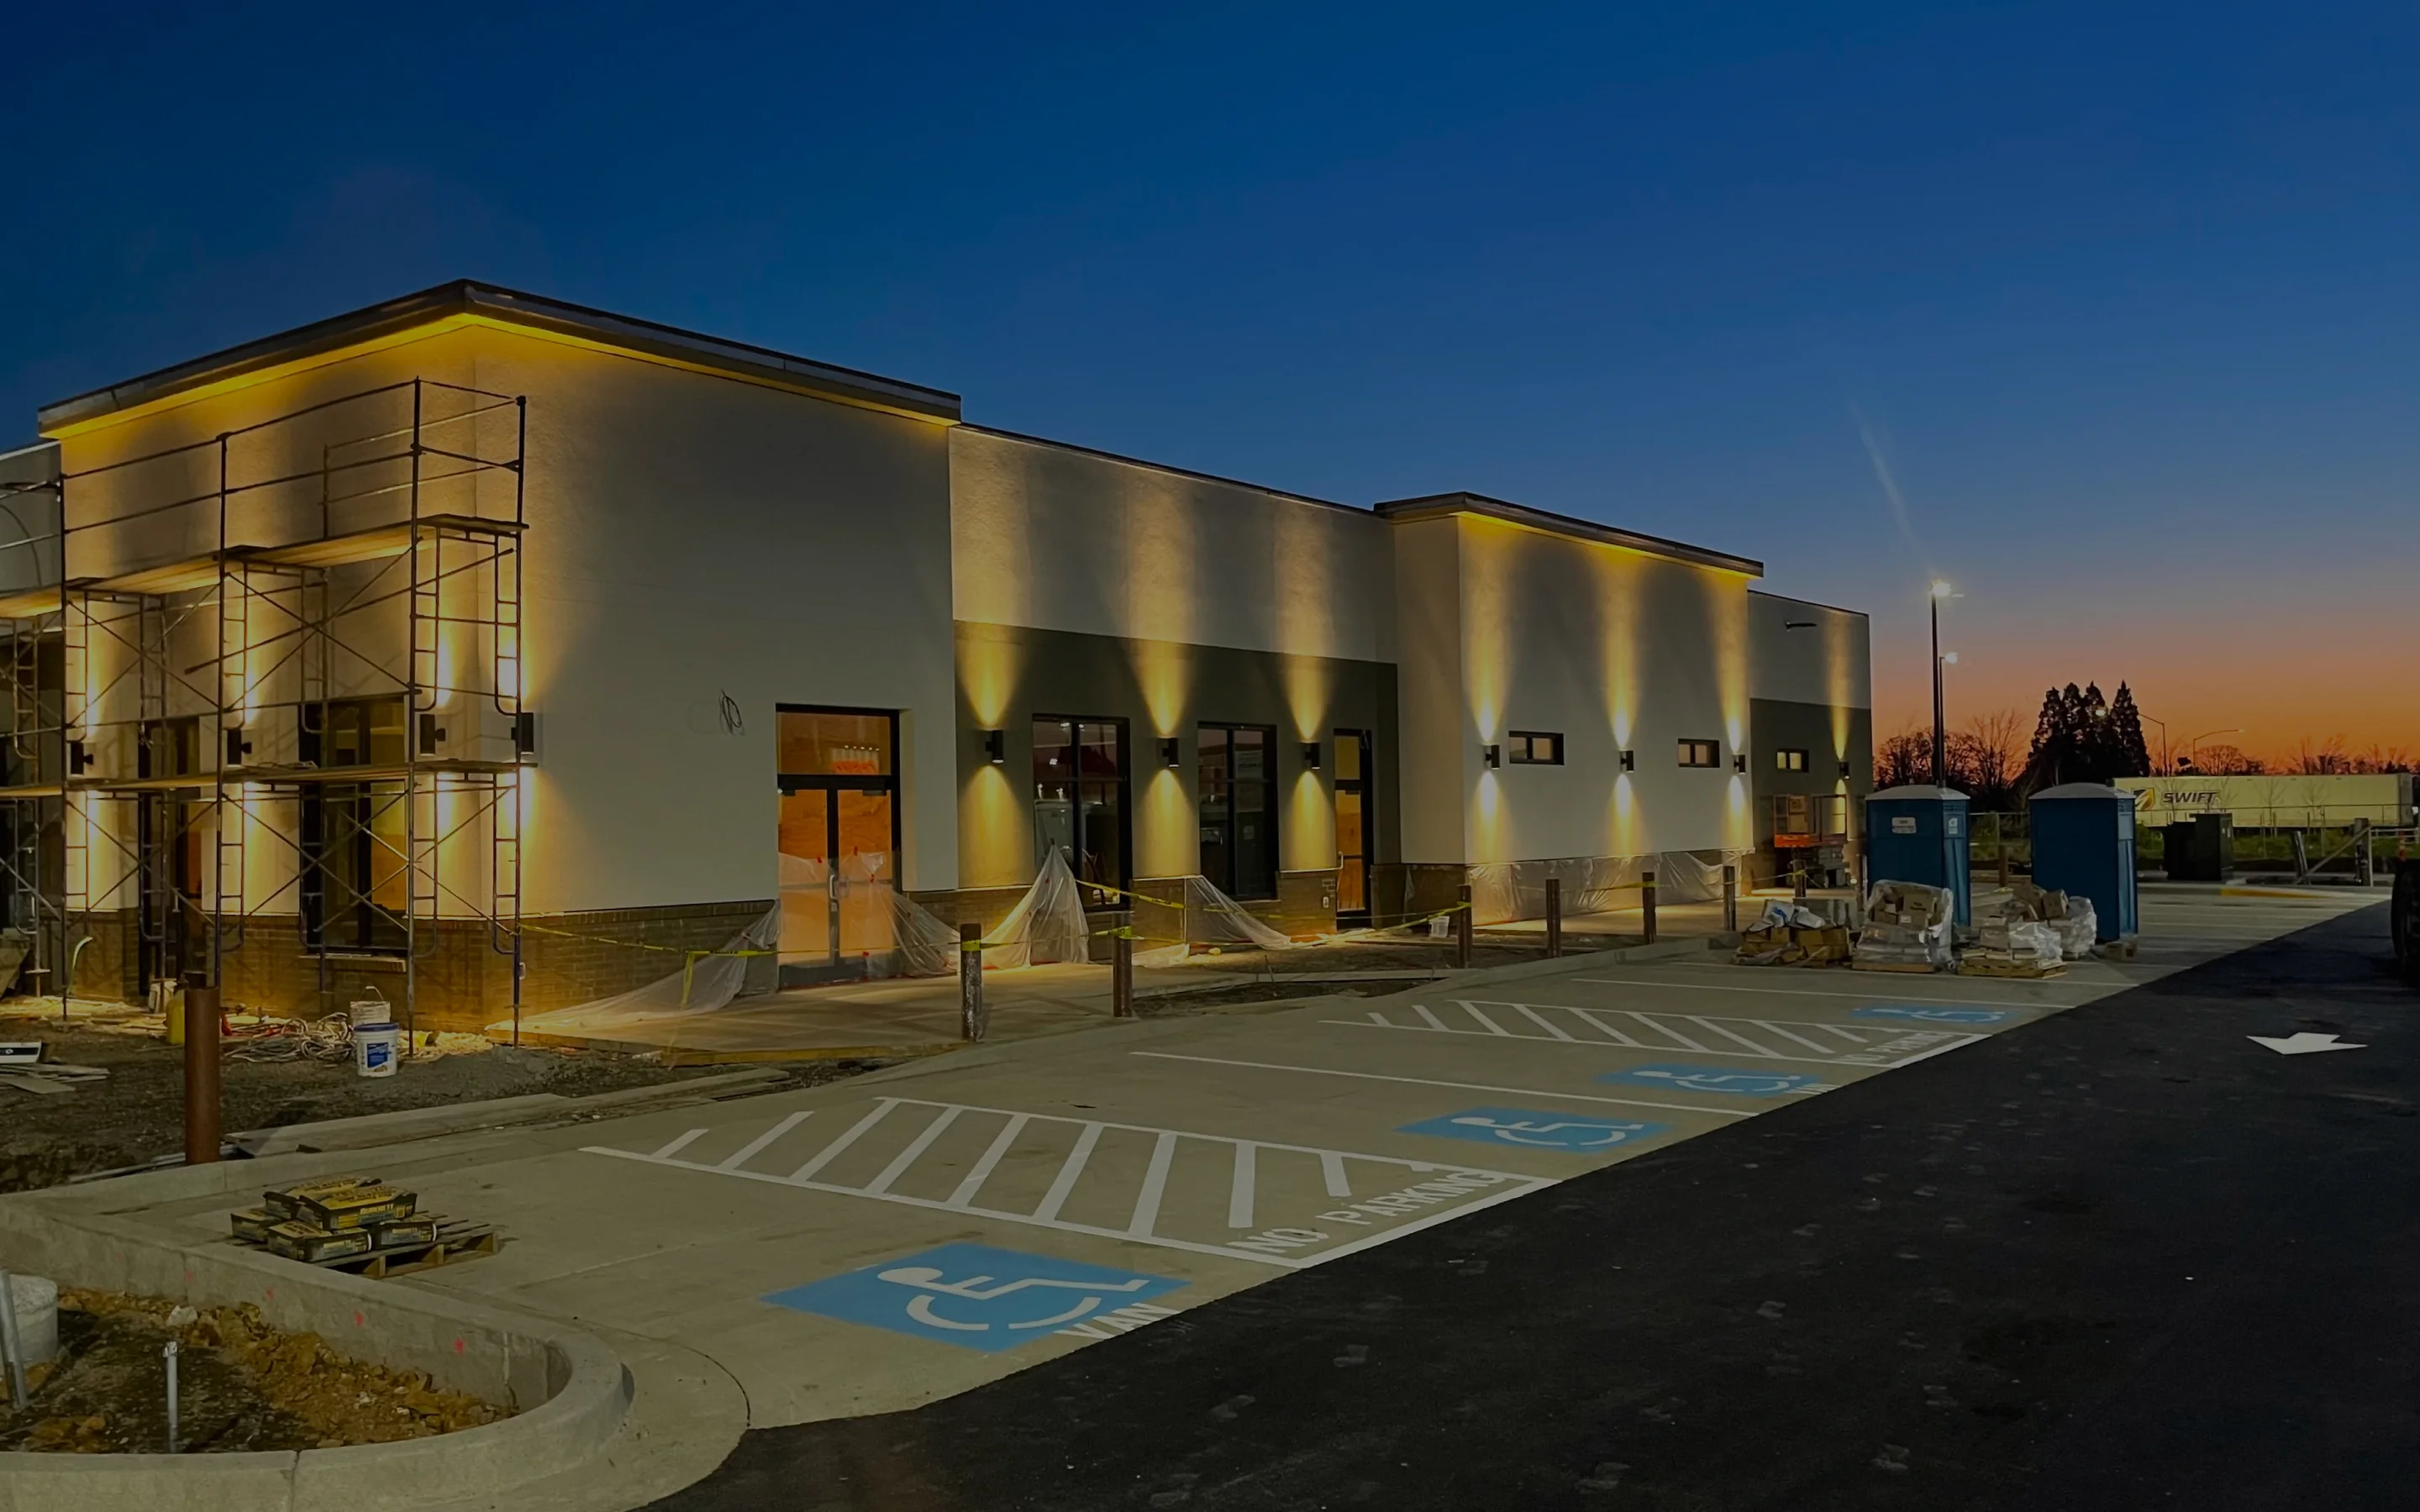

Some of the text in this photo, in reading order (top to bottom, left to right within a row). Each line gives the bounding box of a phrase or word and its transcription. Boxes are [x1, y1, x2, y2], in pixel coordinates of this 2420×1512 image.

[2163, 791, 2218, 804] SWIFT
[1227, 1170, 1507, 1253] NO PARKING
[1052, 1302, 1181, 1340] VAN
